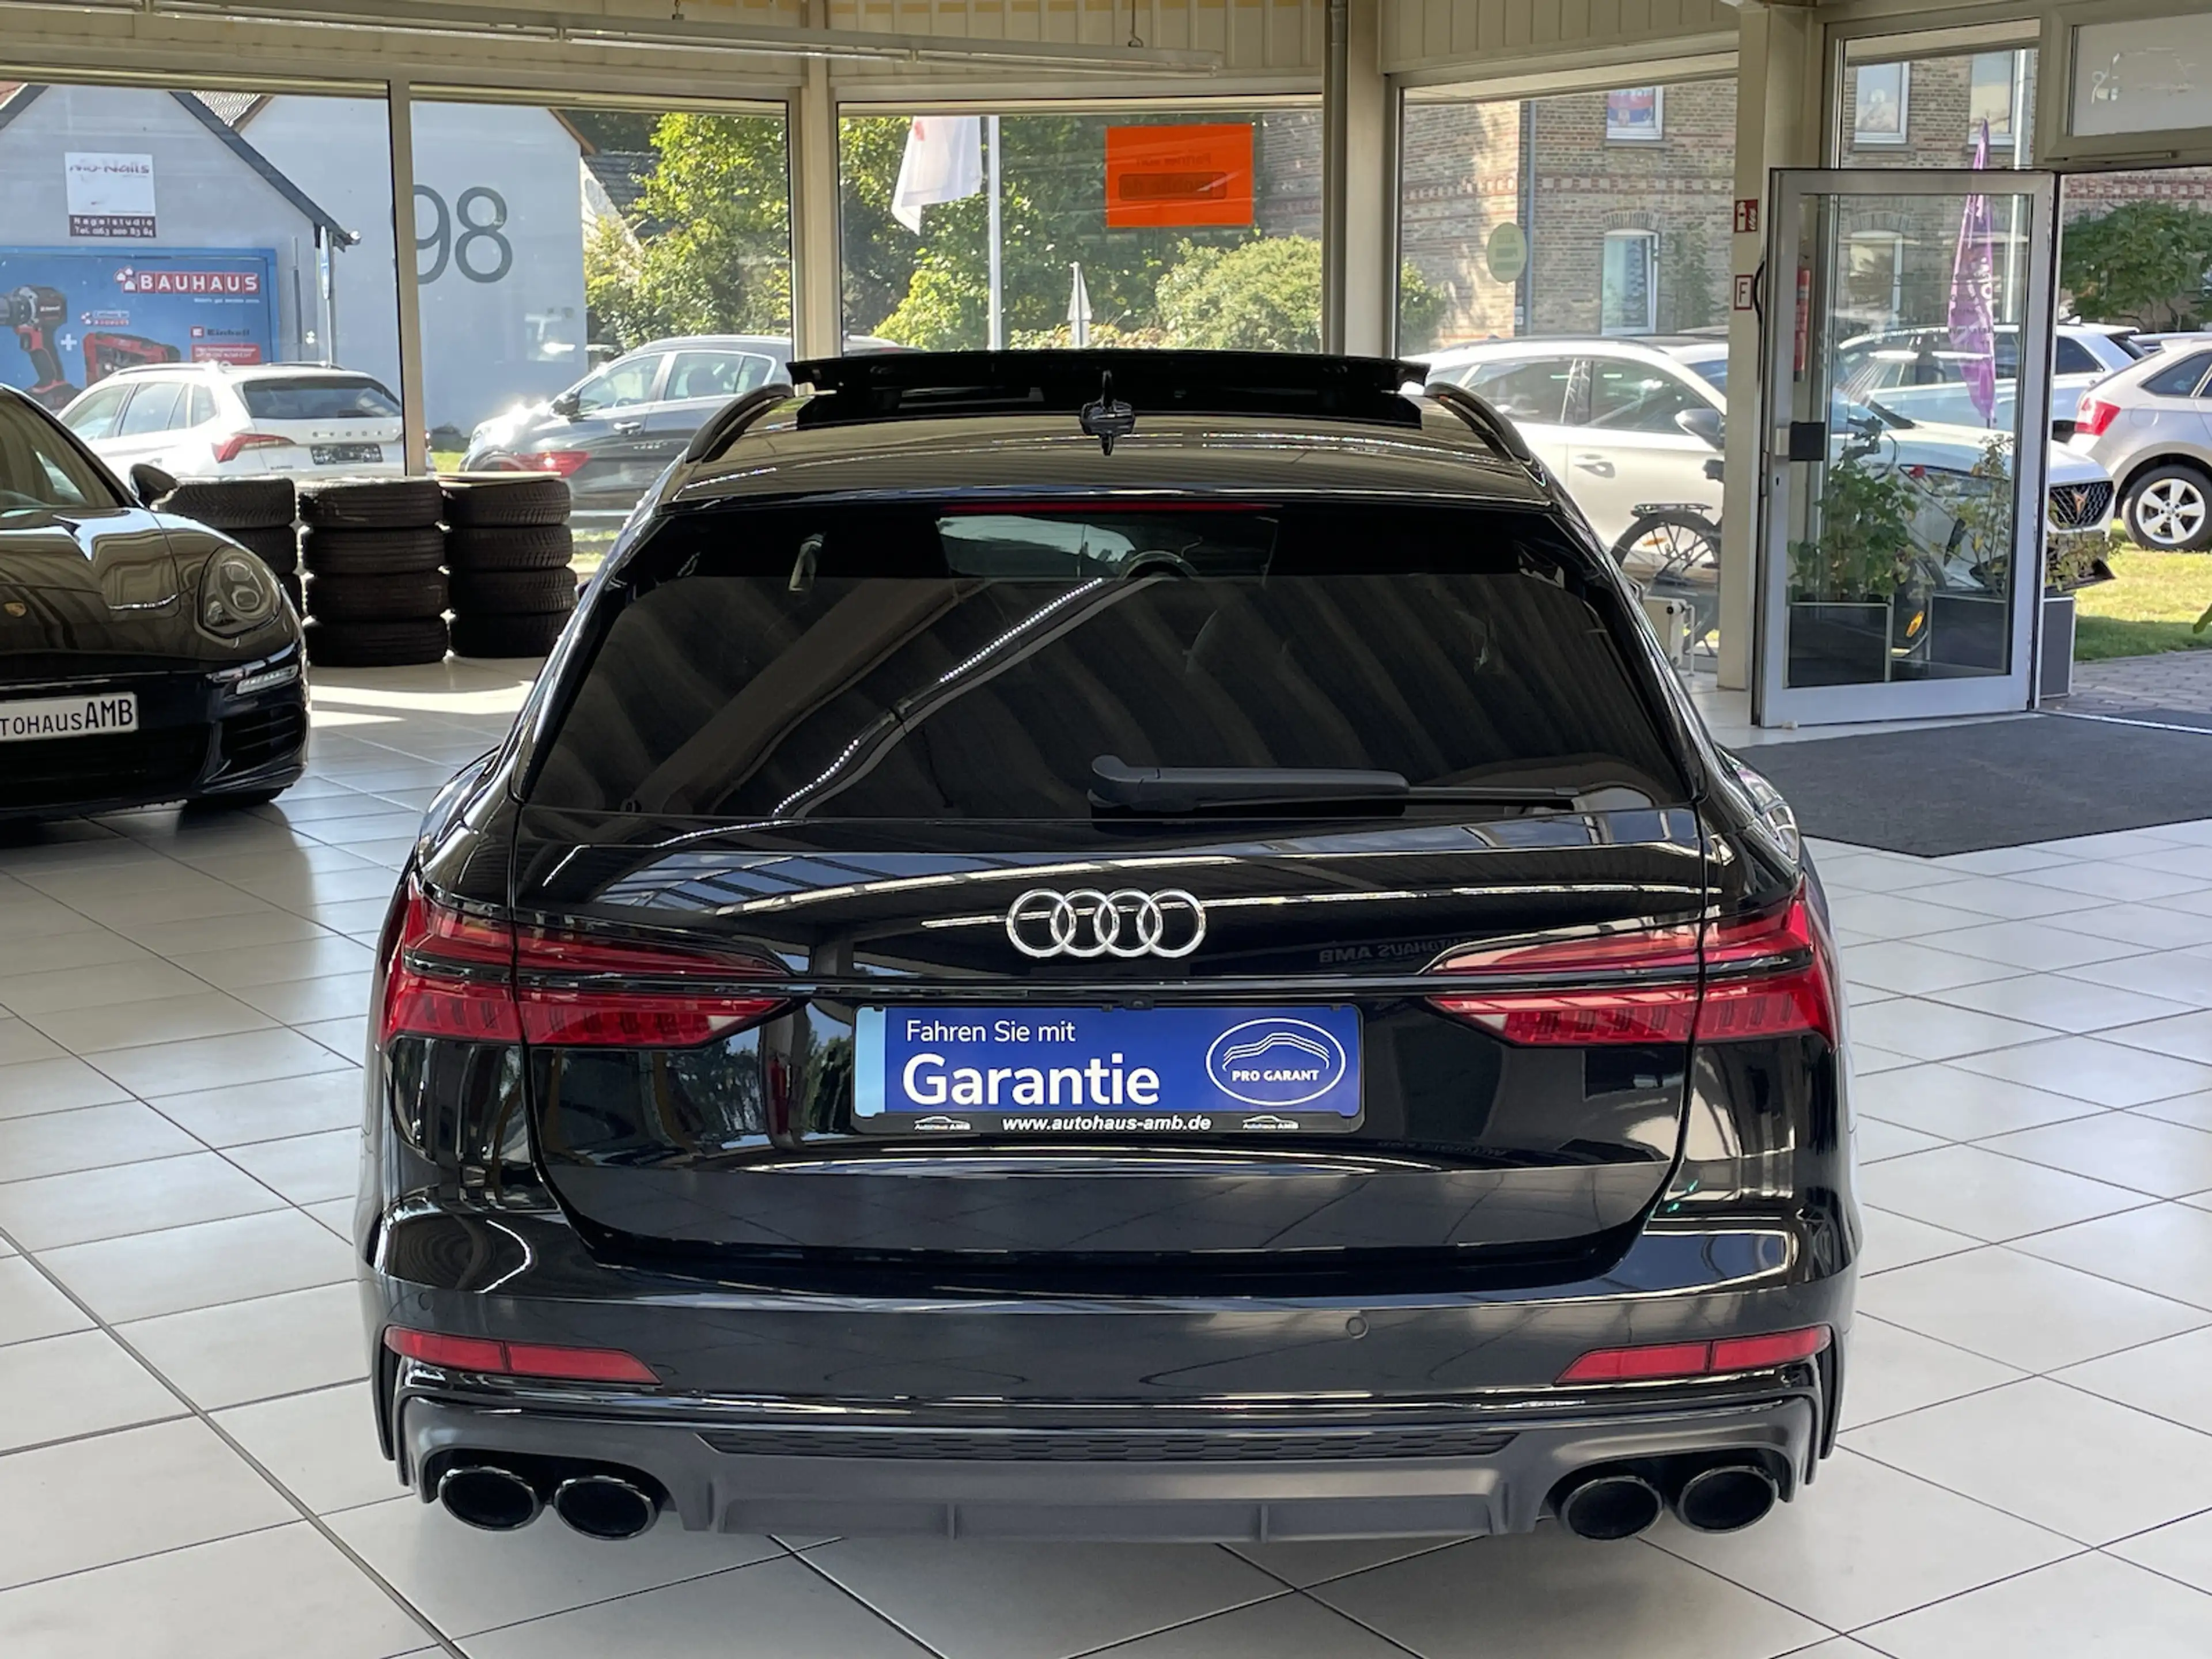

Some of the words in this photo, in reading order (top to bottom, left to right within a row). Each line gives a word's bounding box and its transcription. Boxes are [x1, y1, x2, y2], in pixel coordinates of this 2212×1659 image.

[140, 274, 257, 291] BAUHAUS
[906, 1020, 986, 1042] Fahren
[994, 1020, 1031, 1042] Sie
[1037, 1020, 1076, 1042] mit
[902, 1052, 1160, 1105] Garantie
[1232, 1070, 1260, 1081] PRO
[1263, 1070, 1320, 1081] GARANT
[1002, 1115, 1211, 1131] www.autohaus-amb.de
